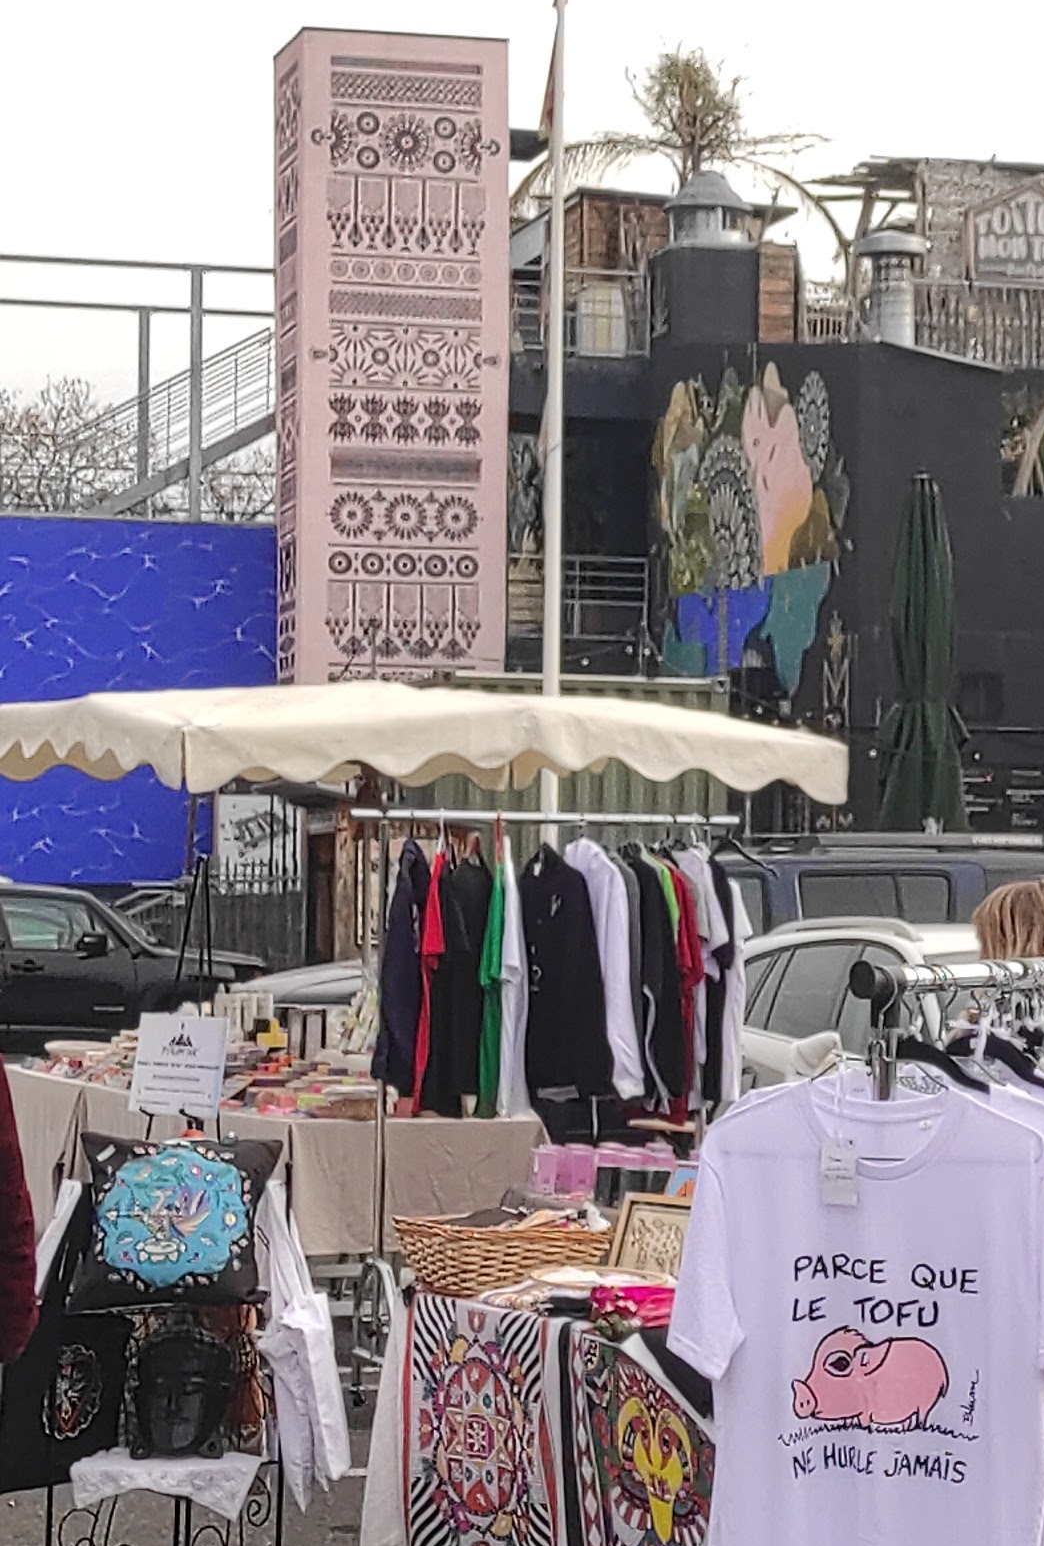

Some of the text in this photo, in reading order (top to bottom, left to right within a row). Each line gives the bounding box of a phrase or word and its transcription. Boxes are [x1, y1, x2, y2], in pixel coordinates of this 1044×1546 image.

[793, 1252, 980, 1294] PARCE QUE
[791, 1296, 940, 1328] LE TOFU
[792, 1446, 818, 1480] NE
[823, 1442, 879, 1476] HURLE
